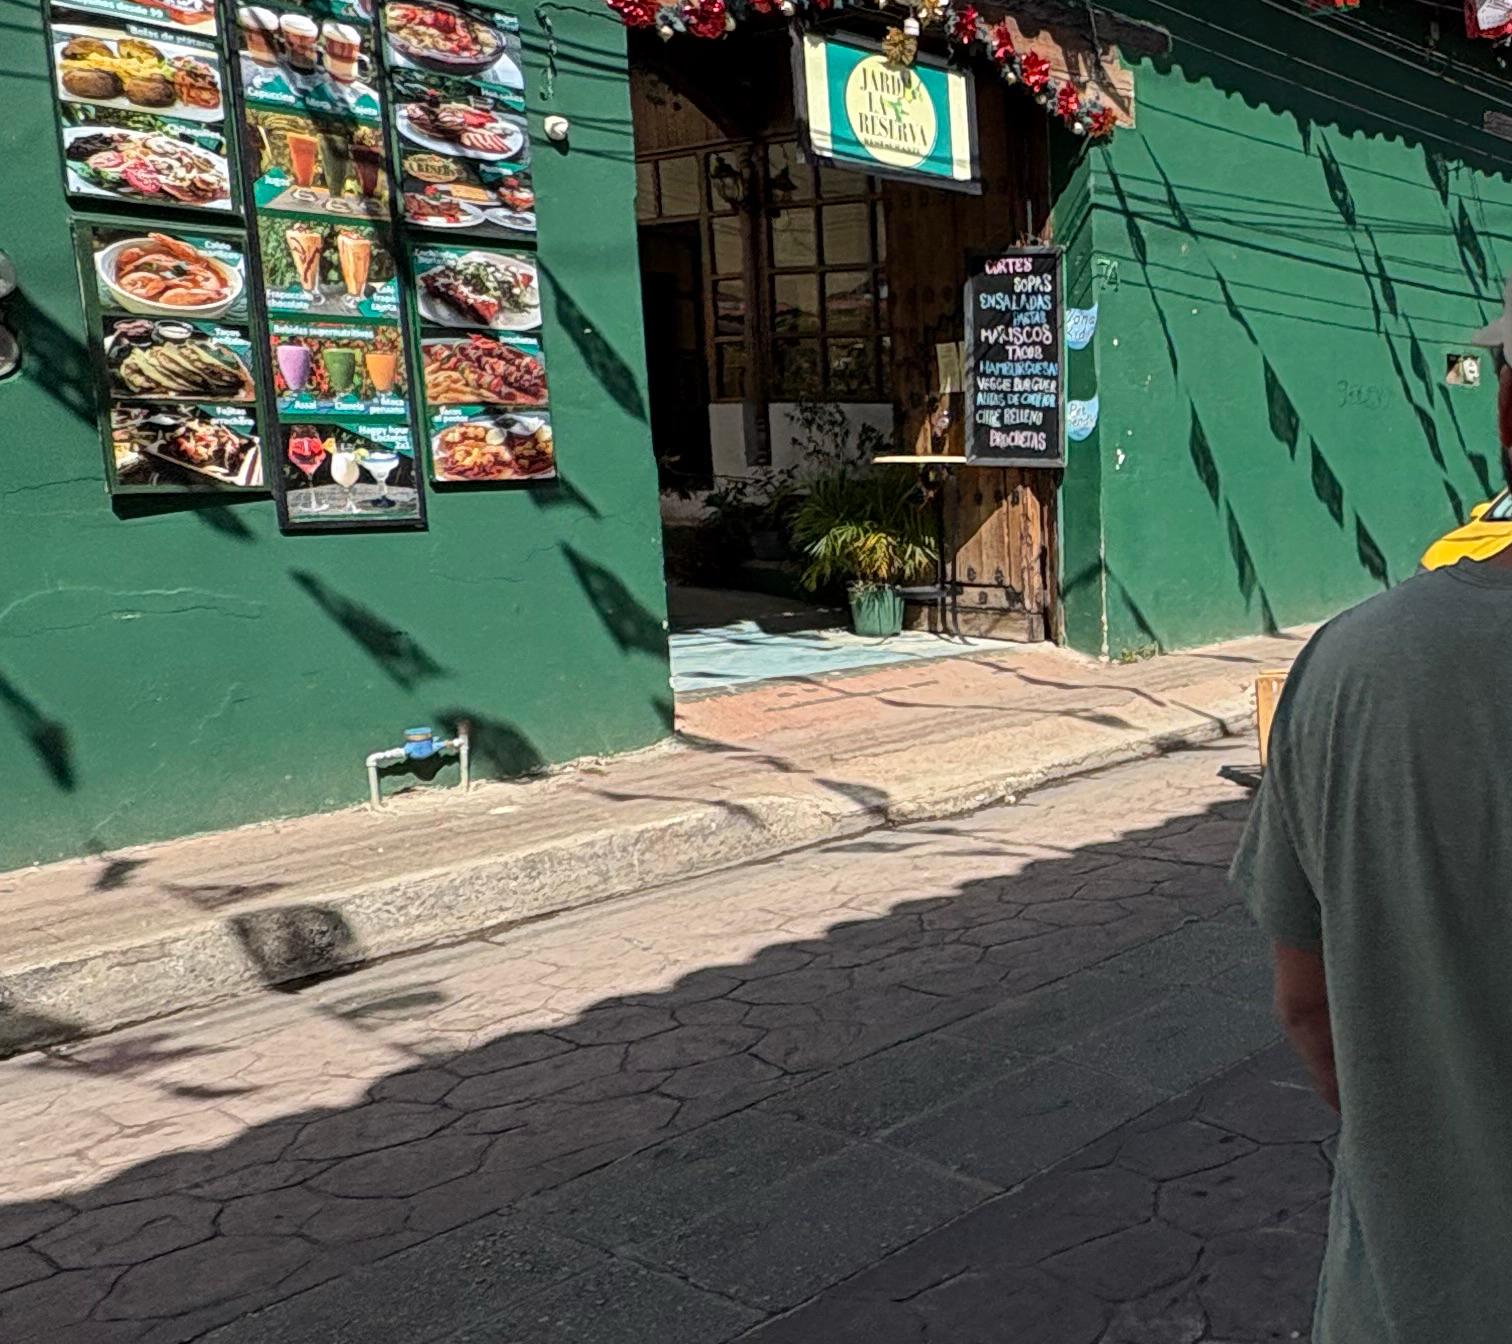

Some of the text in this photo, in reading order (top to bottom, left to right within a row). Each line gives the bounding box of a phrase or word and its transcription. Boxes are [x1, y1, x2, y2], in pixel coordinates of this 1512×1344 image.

[868, 91, 887, 115] LA
[858, 112, 928, 147] RESERVA
[1013, 273, 1052, 293] SOPAS
[979, 292, 1052, 311] ENSALADAS
[1013, 310, 1047, 326] PASTAS
[980, 323, 1053, 345] MARISCOS
[1005, 345, 1044, 360] TACOS
[976, 376, 1012, 391] VEGGIE
[1007, 393, 1020, 406] DE
[1003, 408, 1043, 426] RELLENO
[358, 424, 387, 436] Happy
